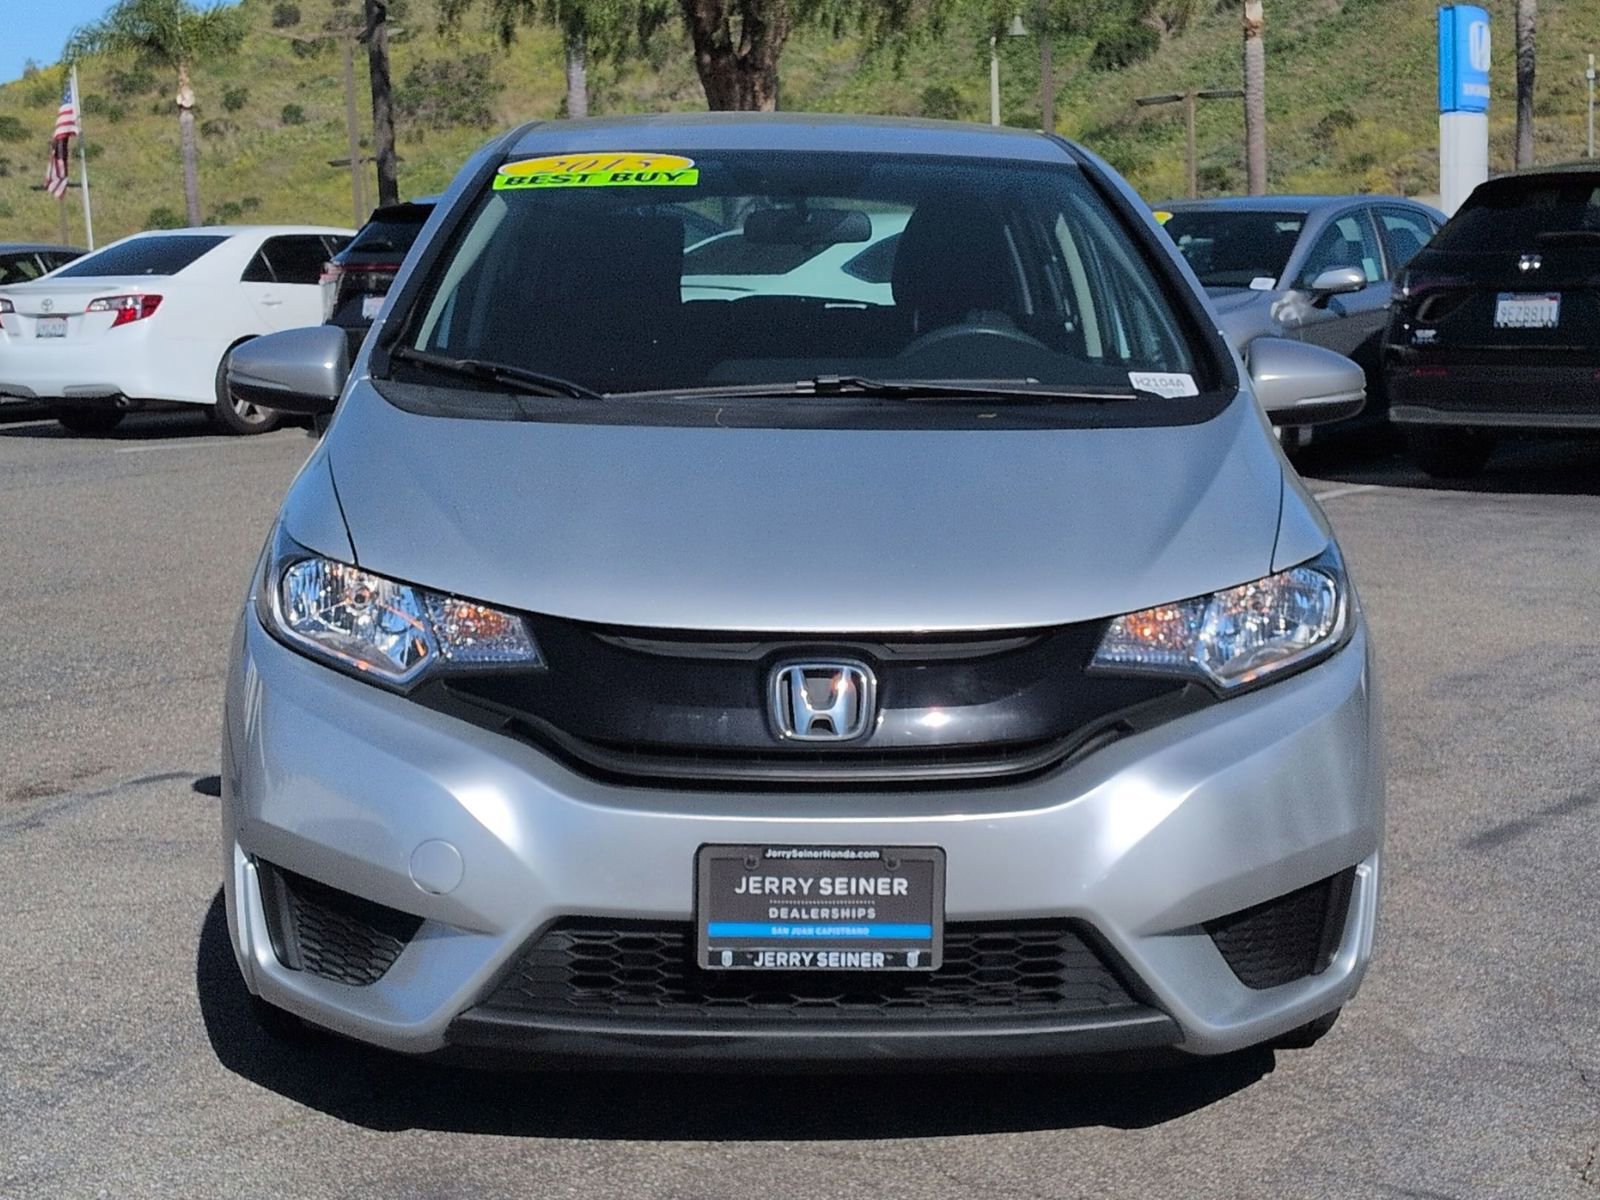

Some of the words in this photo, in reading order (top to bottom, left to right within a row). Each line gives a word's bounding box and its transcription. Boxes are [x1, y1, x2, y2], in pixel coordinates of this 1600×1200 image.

[503, 174, 595, 186] BEST
[608, 171, 687, 183] BUY
[765, 849, 880, 859] JerrySeinerHonda.com
[735, 876, 814, 895] JERRY
[819, 877, 909, 896] SEINER
[768, 907, 876, 919] DEALERSHIPS
[753, 951, 812, 967] JERRY
[817, 952, 885, 968] SEINER
